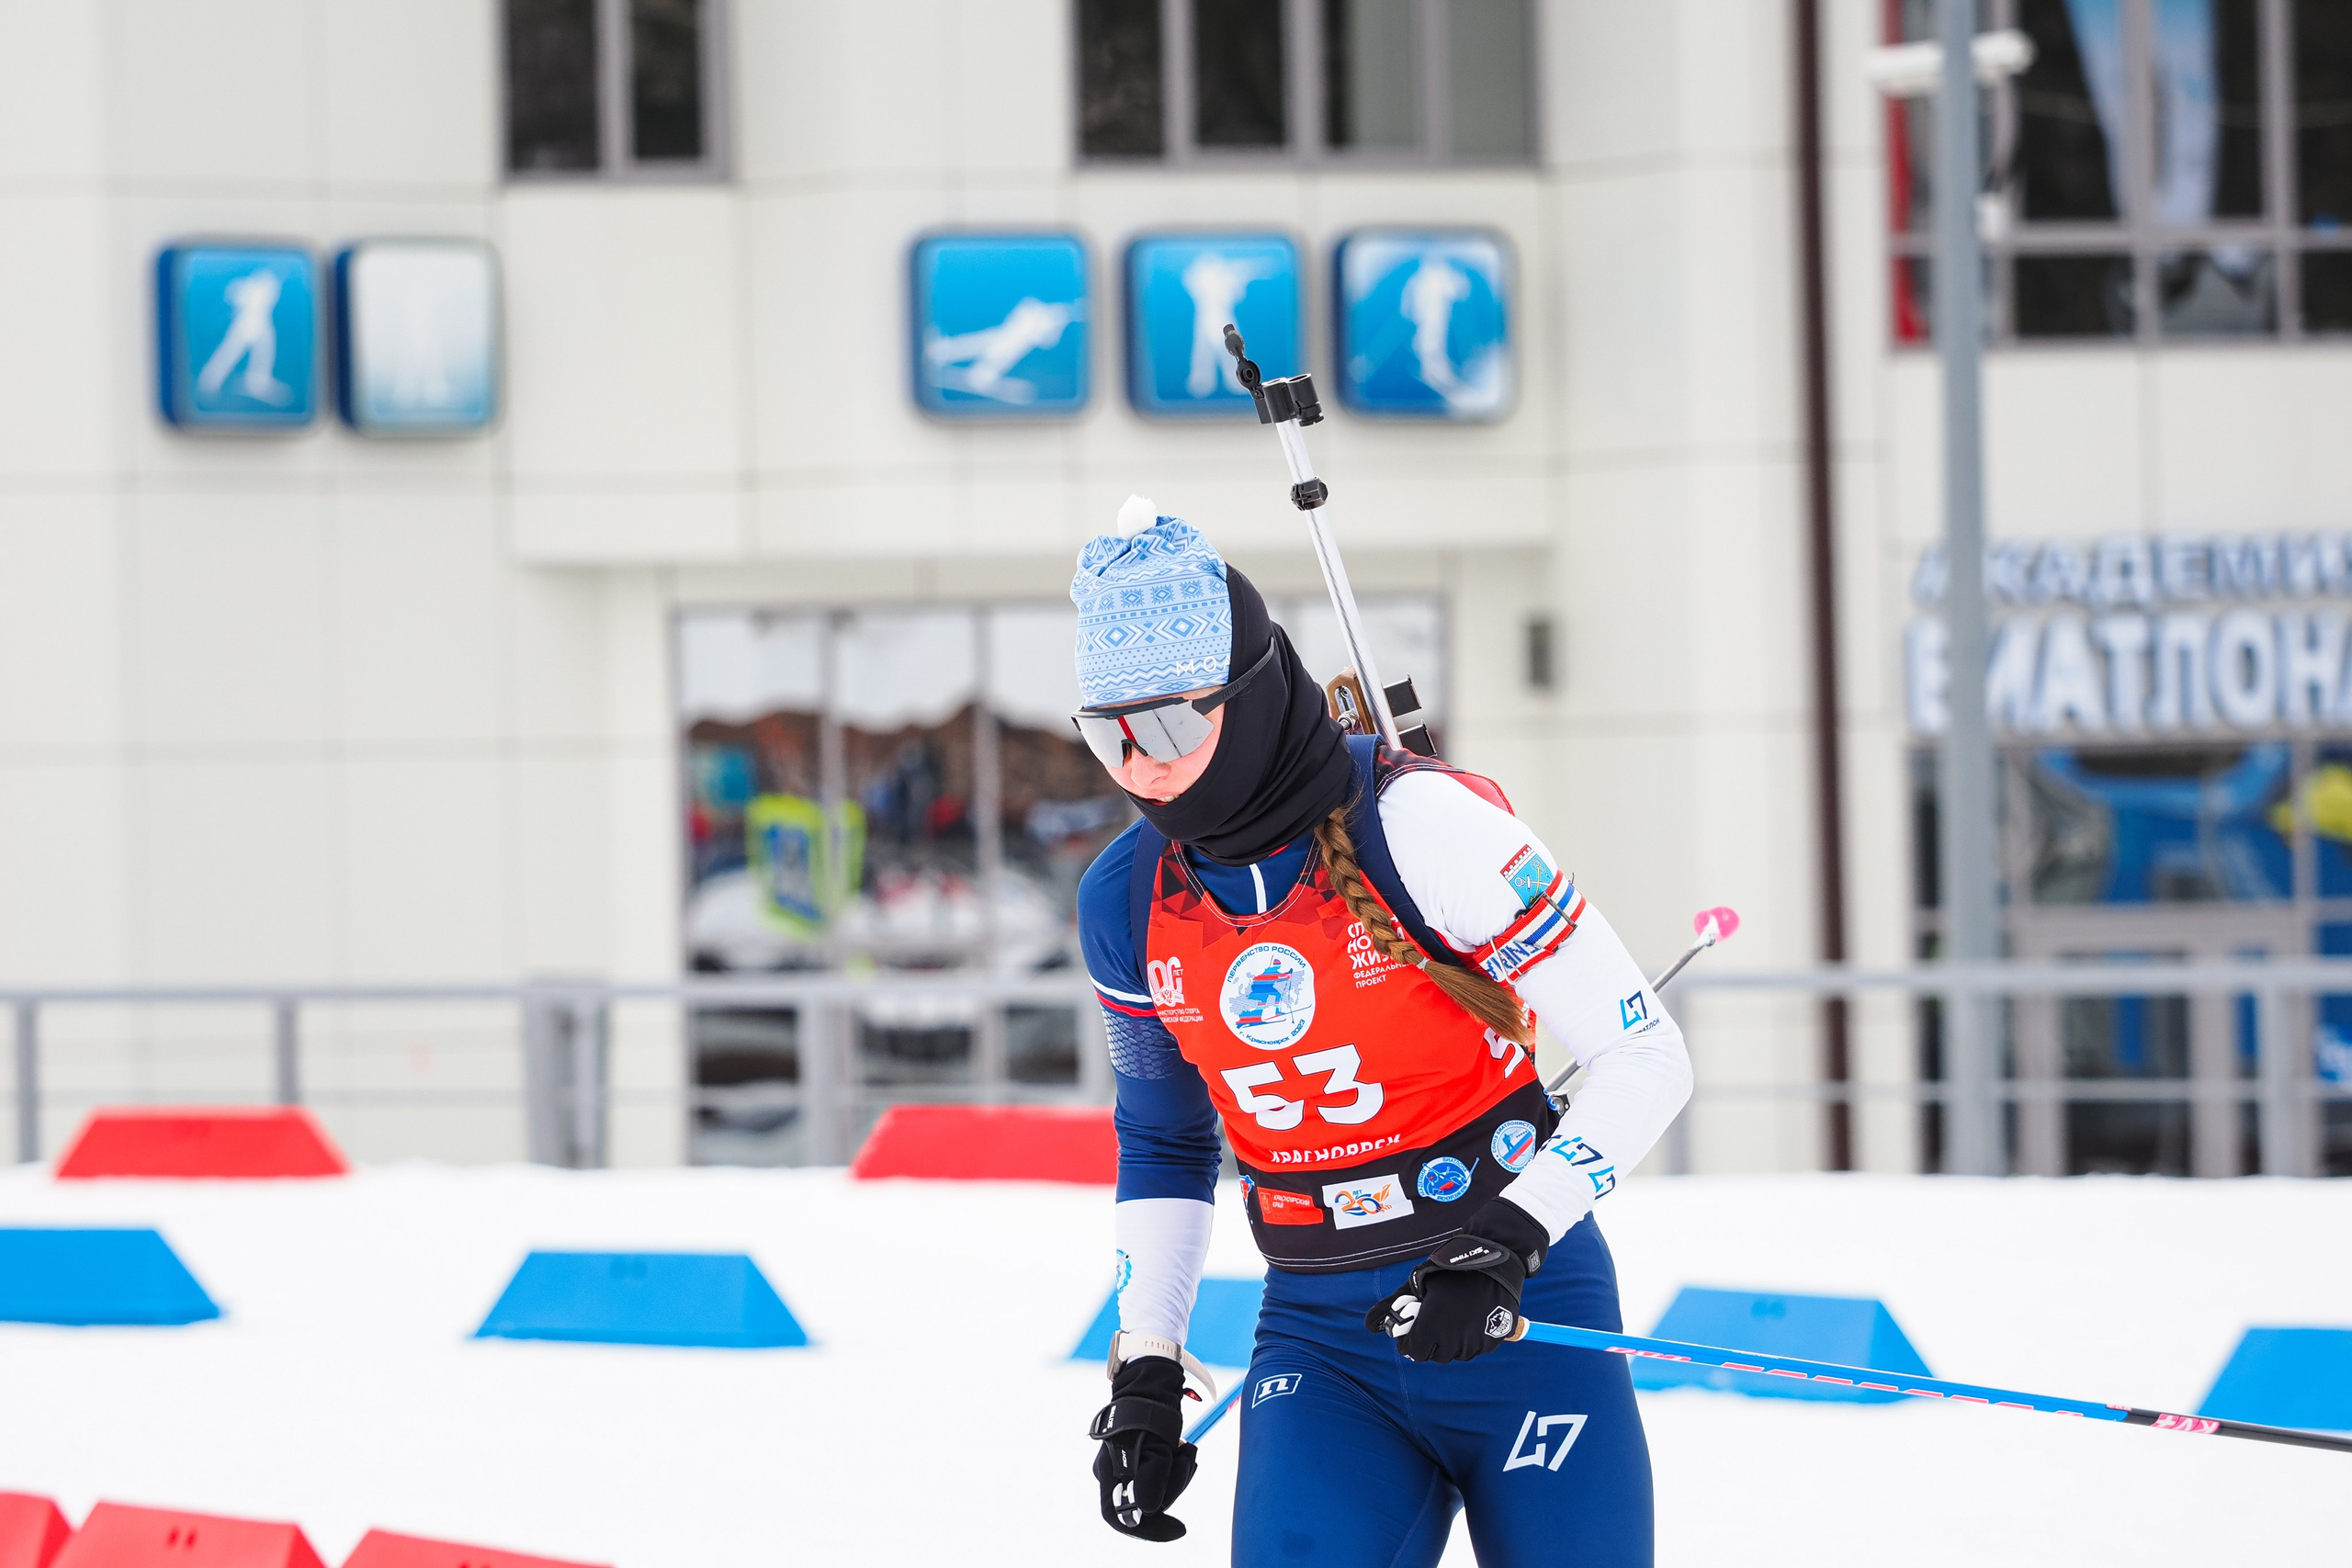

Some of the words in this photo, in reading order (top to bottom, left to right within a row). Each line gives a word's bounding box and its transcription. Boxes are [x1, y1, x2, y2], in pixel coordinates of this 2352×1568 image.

[1912, 535, 2352, 606] АКАДЕМИ
[1906, 611, 2352, 732] БИАТЛОН
[1227, 945, 1270, 983] ПЕРВЕНСТВО
[1272, 945, 1306, 968] РОССИИ
[1355, 975, 1386, 988] ПРОЕКТ
[1246, 1033, 1291, 1045] Красноярск
[1291, 1019, 1306, 1037] 2023
[1219, 1043, 1385, 1131] 53
